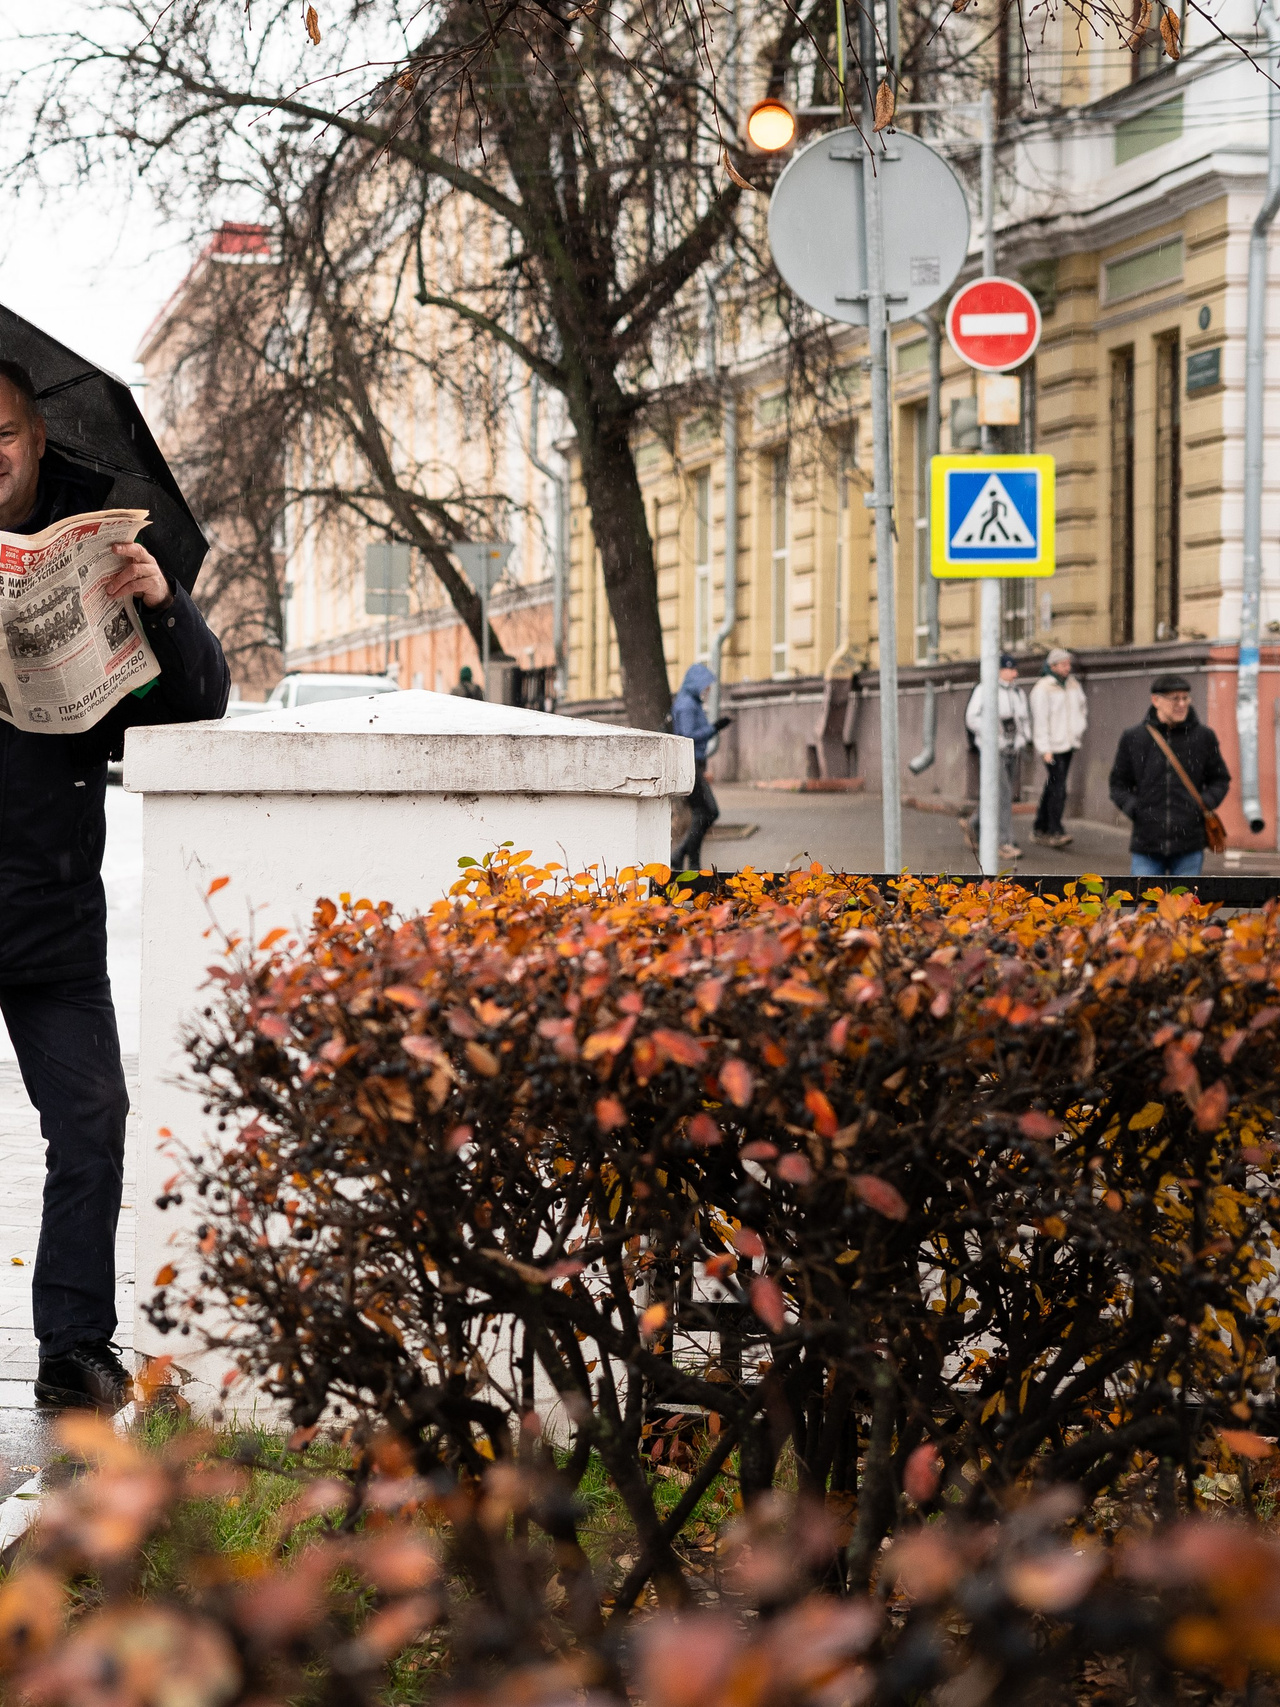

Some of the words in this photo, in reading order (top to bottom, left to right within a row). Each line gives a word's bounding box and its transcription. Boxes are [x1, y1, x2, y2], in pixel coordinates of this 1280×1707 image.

[0, 576, 4, 585] В
[0, 586, 5, 596] К
[58, 650, 145, 714] ПРАВИТЕЛЬСТВО
[60, 683, 119, 722] НИЖЕГОРОДСКОЙ
[118, 661, 148, 686] ОБЛАСТИ
